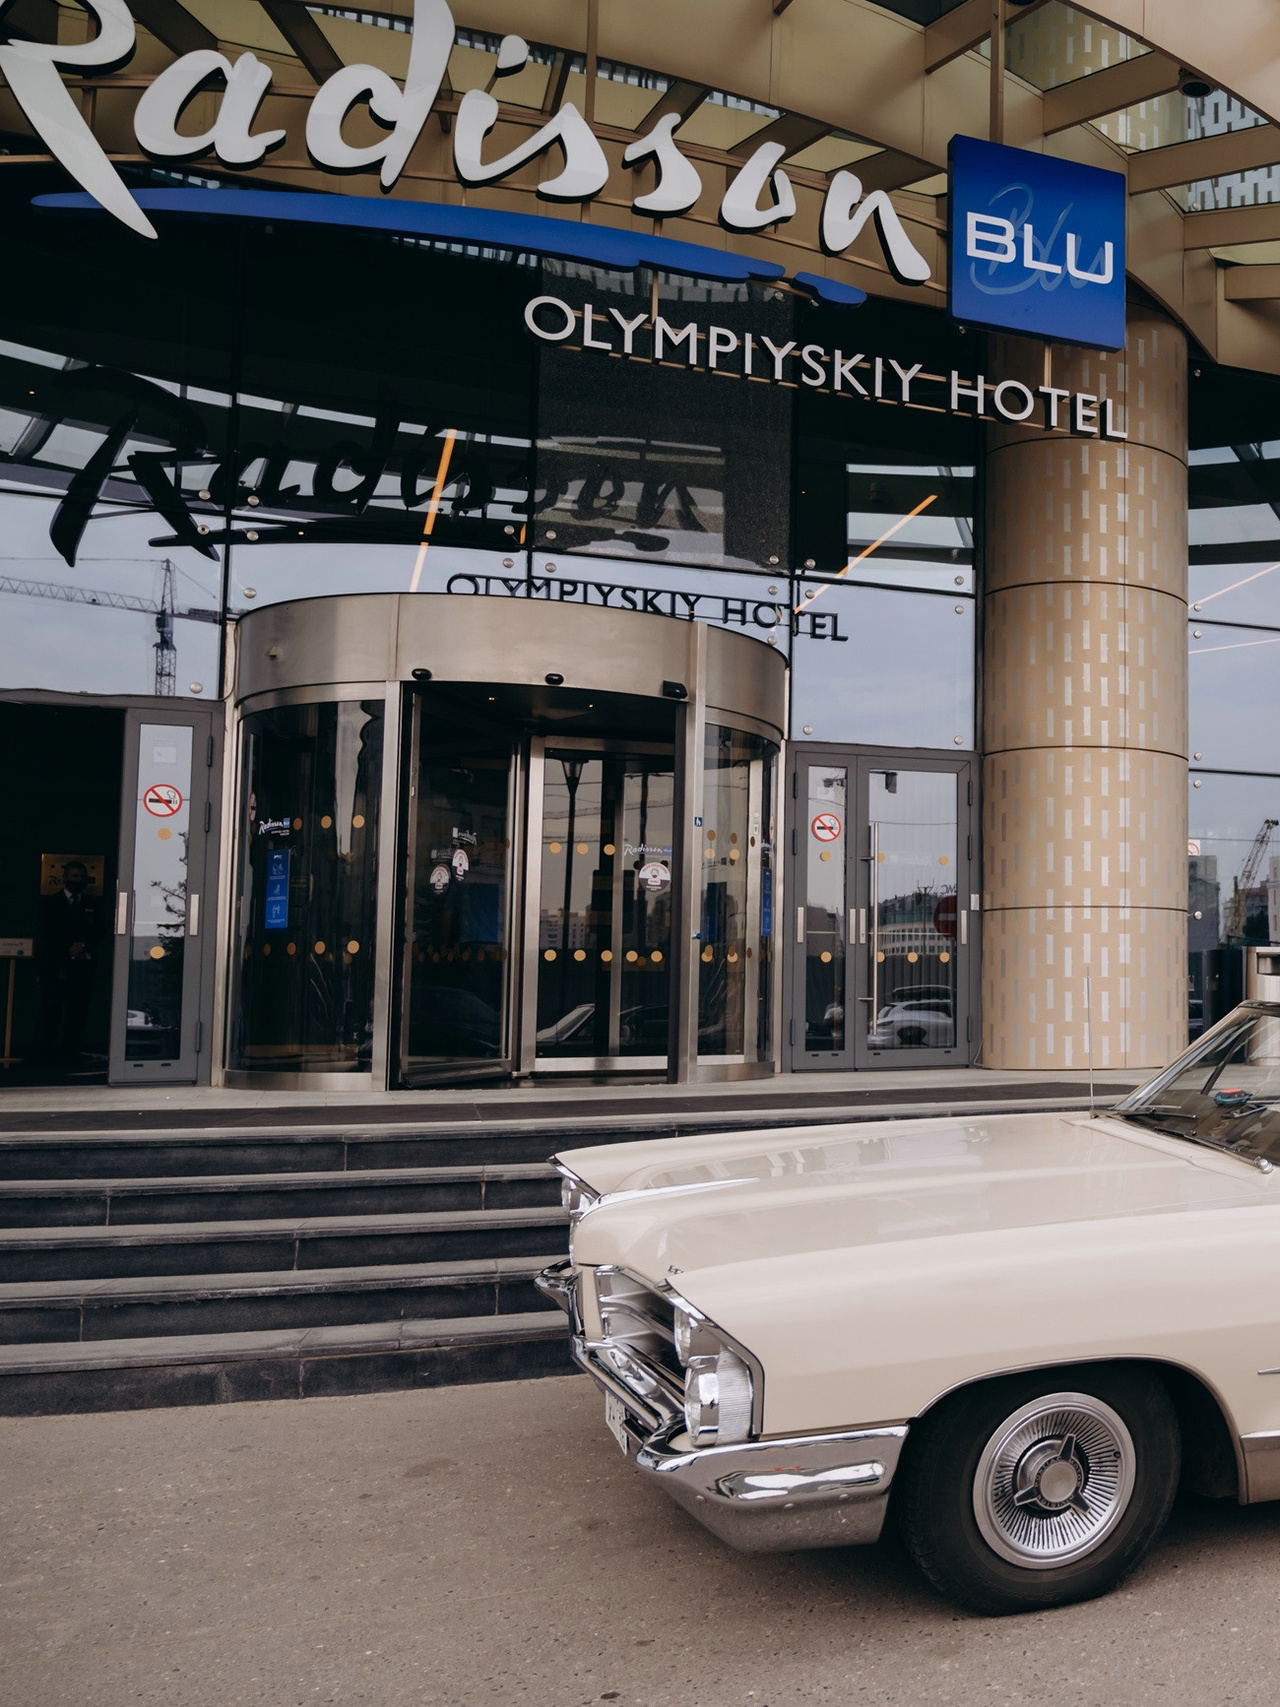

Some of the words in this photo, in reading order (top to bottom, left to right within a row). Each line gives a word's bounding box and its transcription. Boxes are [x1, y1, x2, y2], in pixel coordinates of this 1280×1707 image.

[0, 0, 932, 284] Radisson
[966, 211, 1114, 285] BLU
[524, 296, 923, 402] OLYMPIYSKIY
[950, 370, 1127, 438] HOTEL
